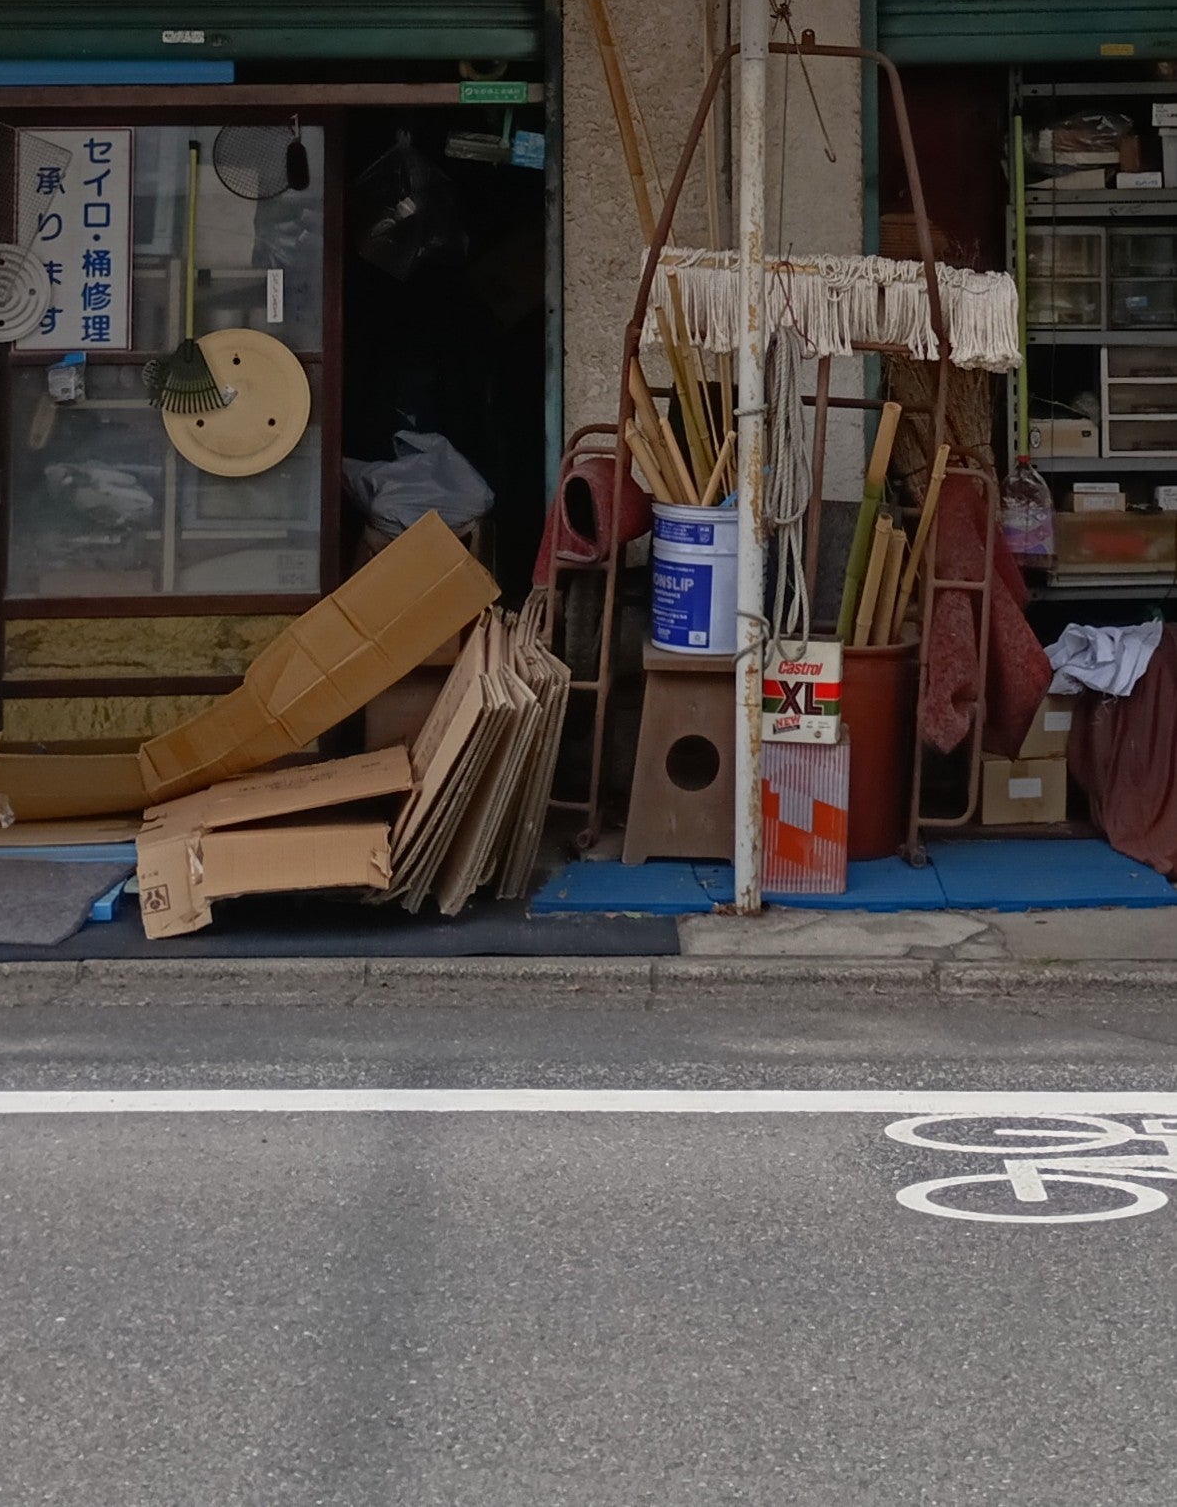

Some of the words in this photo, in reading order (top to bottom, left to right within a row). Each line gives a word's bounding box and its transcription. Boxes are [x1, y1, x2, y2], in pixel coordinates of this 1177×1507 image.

[35, 166, 67, 335] 承ります
[80, 137, 113, 343] セイロ・桶修理
[777, 659, 824, 676] Castrol
[776, 680, 824, 716] XL
[774, 714, 801, 729] NEW
